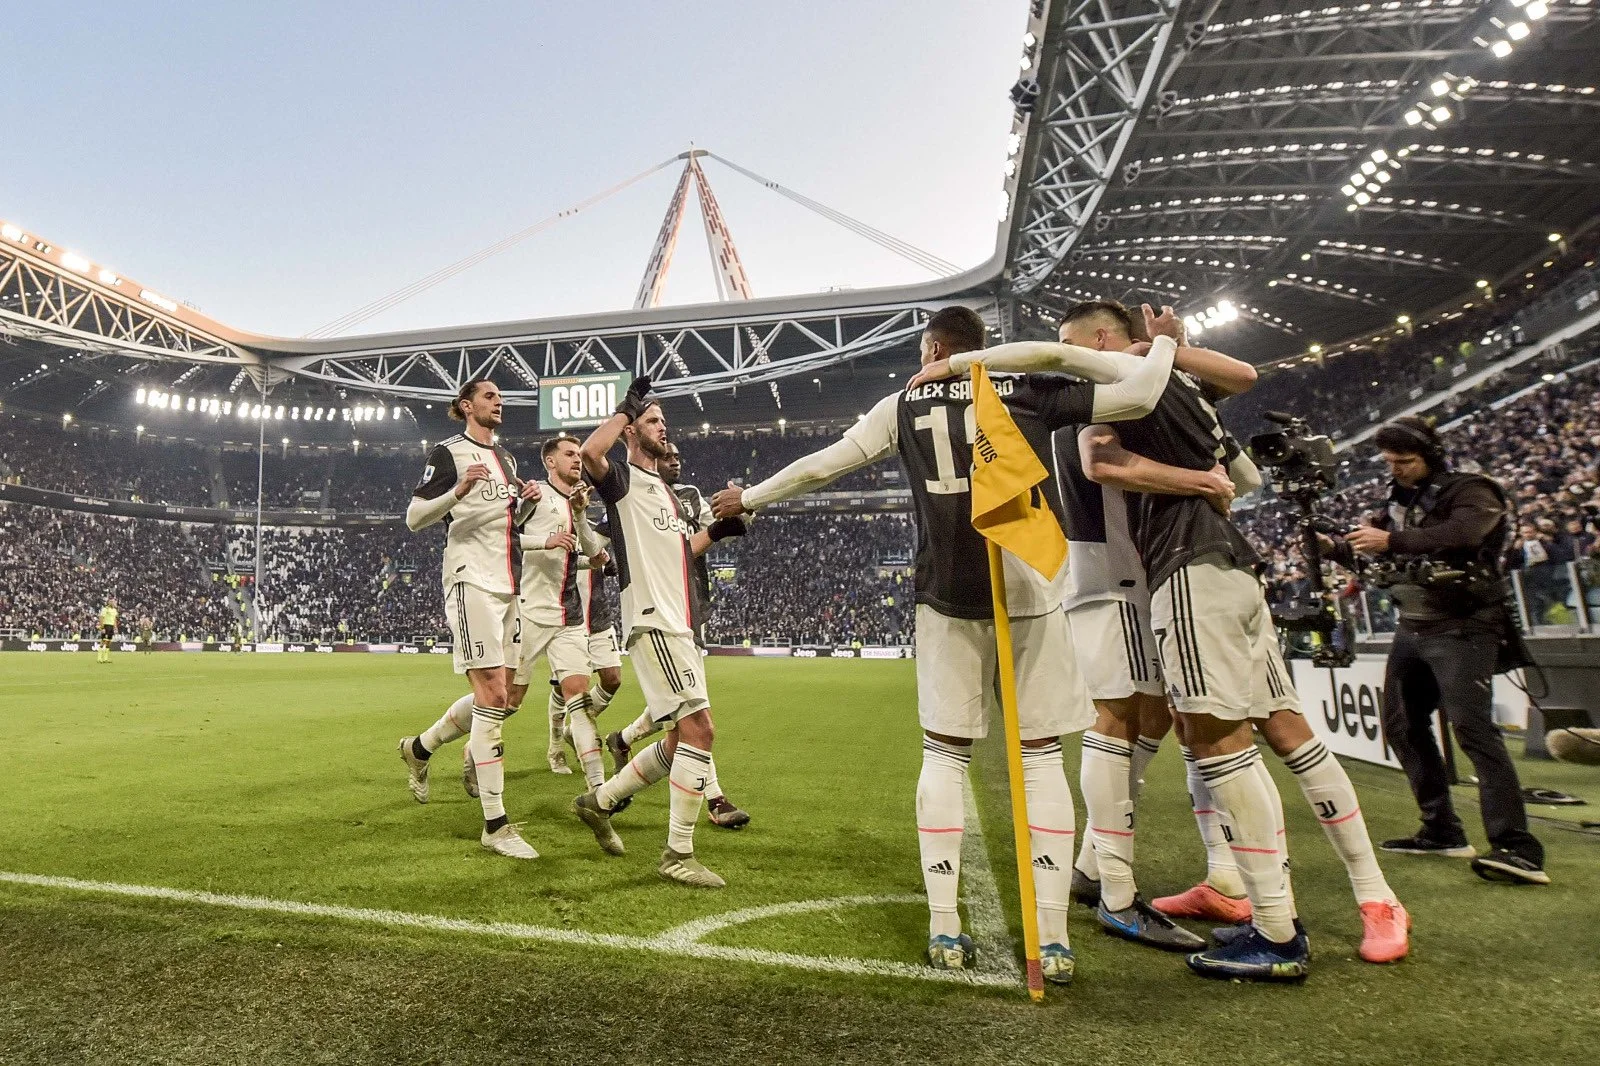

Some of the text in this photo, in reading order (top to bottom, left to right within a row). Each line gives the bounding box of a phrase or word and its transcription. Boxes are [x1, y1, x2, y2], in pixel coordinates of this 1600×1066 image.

[905, 380, 1014, 401] ALEX SARO
[481, 479, 519, 501] Jee
[653, 508, 695, 541] Jeep
[793, 648, 817, 658] Jeep
[831, 648, 855, 658] Jeep
